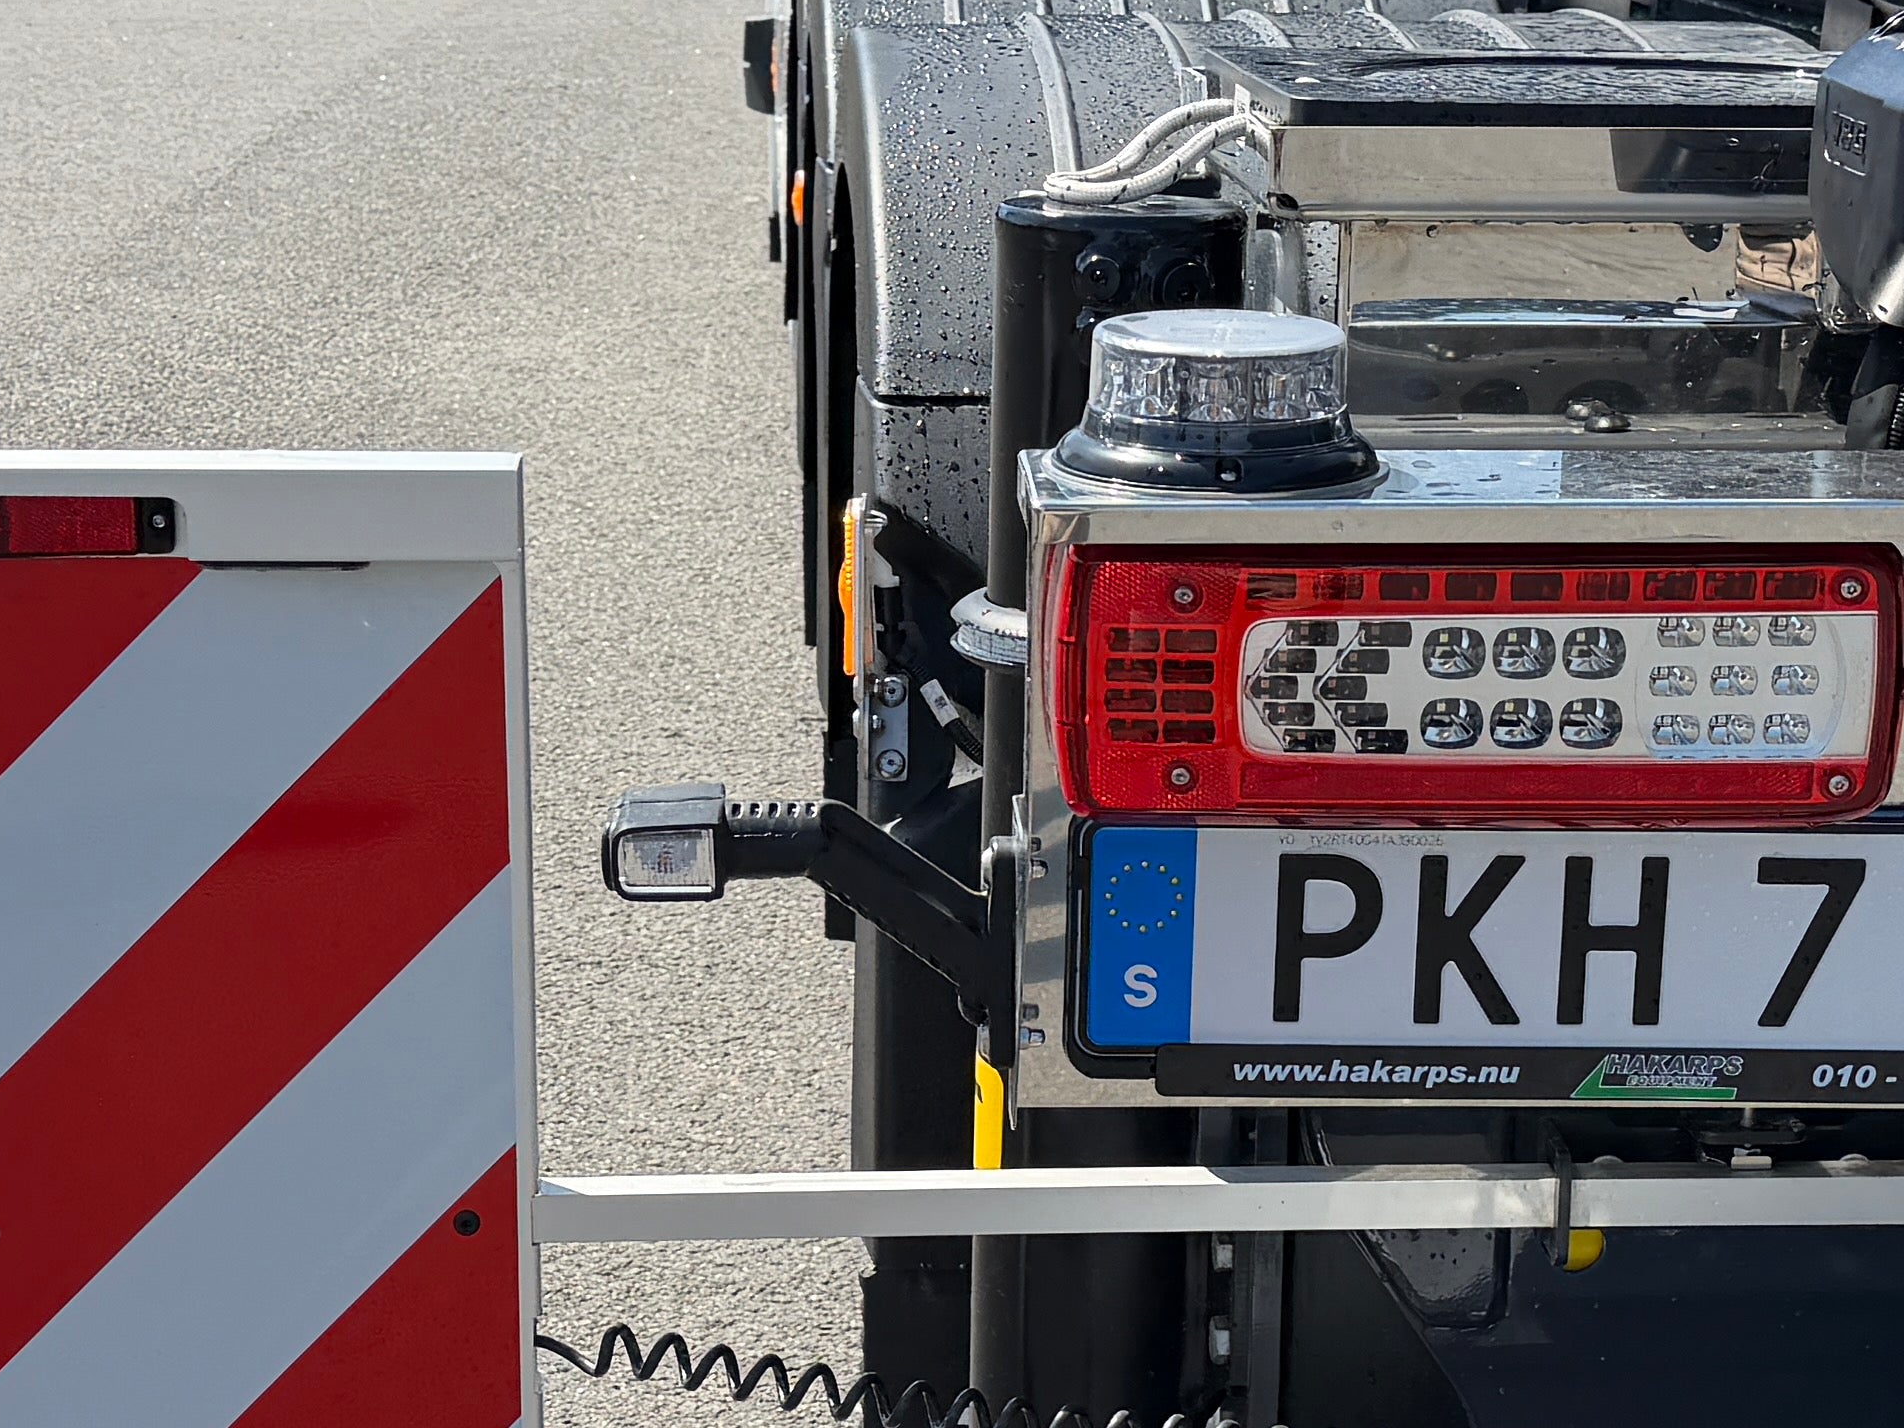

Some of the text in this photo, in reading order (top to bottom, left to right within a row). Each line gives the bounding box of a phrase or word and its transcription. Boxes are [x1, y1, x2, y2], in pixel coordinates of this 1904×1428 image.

[1272, 852, 1671, 1026] PKH
[1123, 964, 1159, 1009] S
[1233, 1059, 1521, 1089] www.hakarps.nu
[1606, 1053, 1744, 1076] HAKARPS
[1812, 1064, 1877, 1088] 010
[1625, 1075, 1718, 1087] EQUIPMENT
